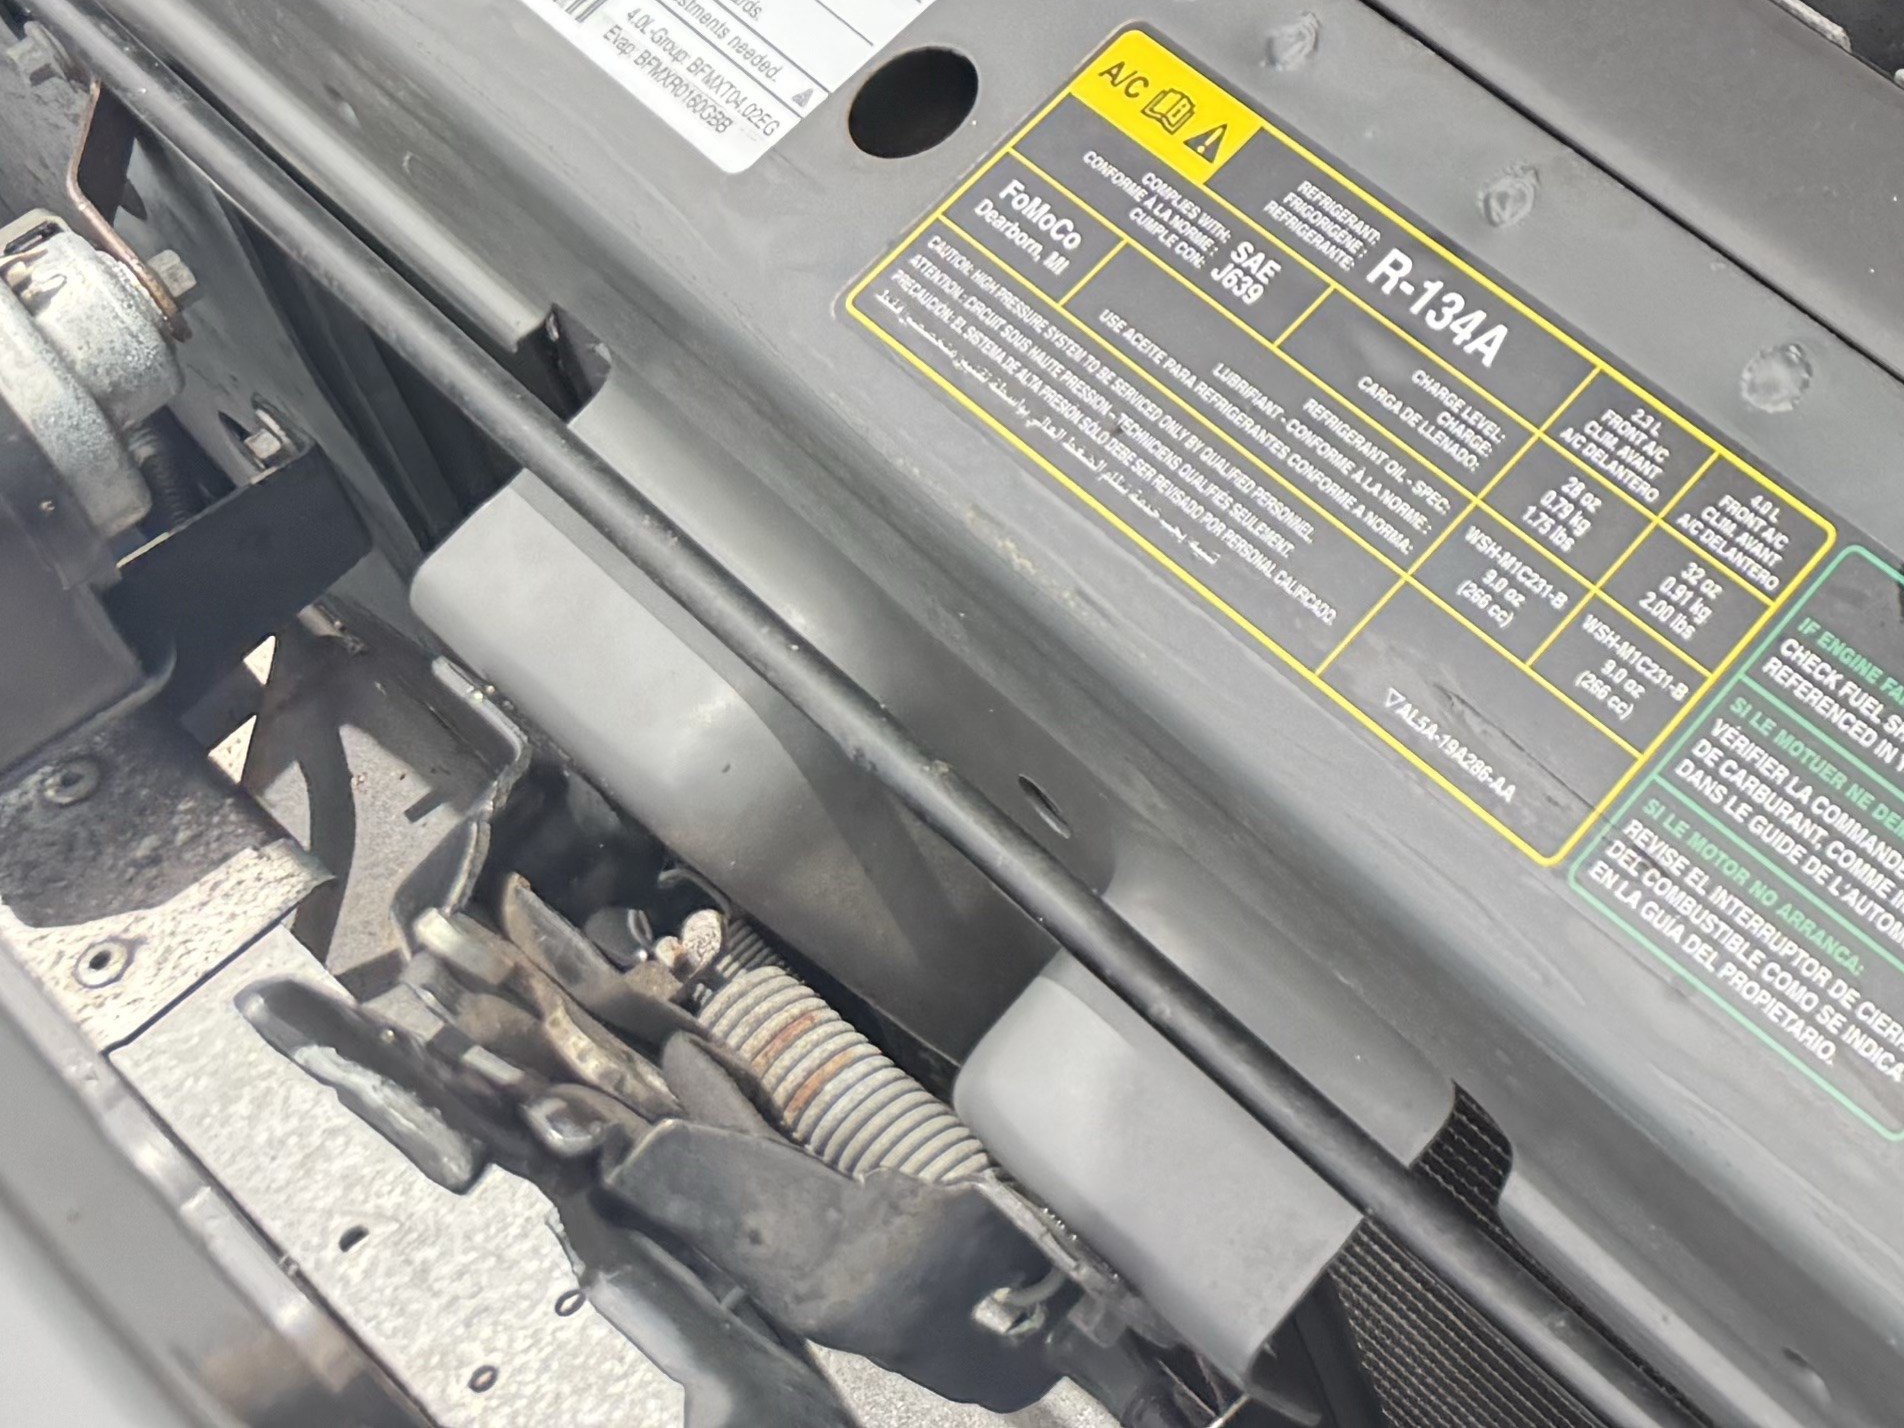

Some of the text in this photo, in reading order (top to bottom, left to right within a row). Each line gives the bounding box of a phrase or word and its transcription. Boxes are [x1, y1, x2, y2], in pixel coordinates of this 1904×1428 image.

[725, 32, 786, 83] needed.
[1097, 56, 1152, 101] A/C
[970, 197, 1071, 276] Dearborn, MI
[996, 178, 1089, 253] FoMoCo
[1138, 170, 1234, 244] COMPLIES WITH:
[1261, 198, 1358, 273] REFRIGERANTE:
[1295, 179, 1383, 246] REFRIGERANT:
[1207, 257, 1267, 307] J639
[1226, 238, 1283, 286] SAE
[1363, 246, 1518, 370] R-134A
[1354, 374, 1483, 473] CARGA DE LLENADO:
[1408, 367, 1509, 445] CHARGE LEVEL:
[1433, 409, 1496, 459] CHARGE:
[1599, 407, 1671, 465] FRONT A/C
[1537, 487, 1595, 538] 0.79 kg
[1558, 474, 1603, 514] 28 oz
[1716, 493, 1791, 552] FRONT A/C
[1518, 503, 1580, 554] 1.75 lbs
[1656, 573, 1717, 628] 0.91 kg
[1678, 560, 1724, 601] 32 oz
[1636, 589, 1699, 642] 2.00 lbs
[1776, 635, 1845, 692] CHECK
[1835, 678, 1890, 726] FUEL
[1796, 616, 1820, 639] IF
[1813, 628, 1885, 688] ENGINE
[1760, 654, 1880, 751] REFERENCED
[1871, 737, 1900, 765] IN
[1706, 712, 1794, 787] VÉRIFIER
[1782, 774, 1817, 807] LA
[1689, 736, 1725, 769] DE
[1714, 755, 1831, 852] CARBURANT,
[1821, 837, 1897, 901] COMME
